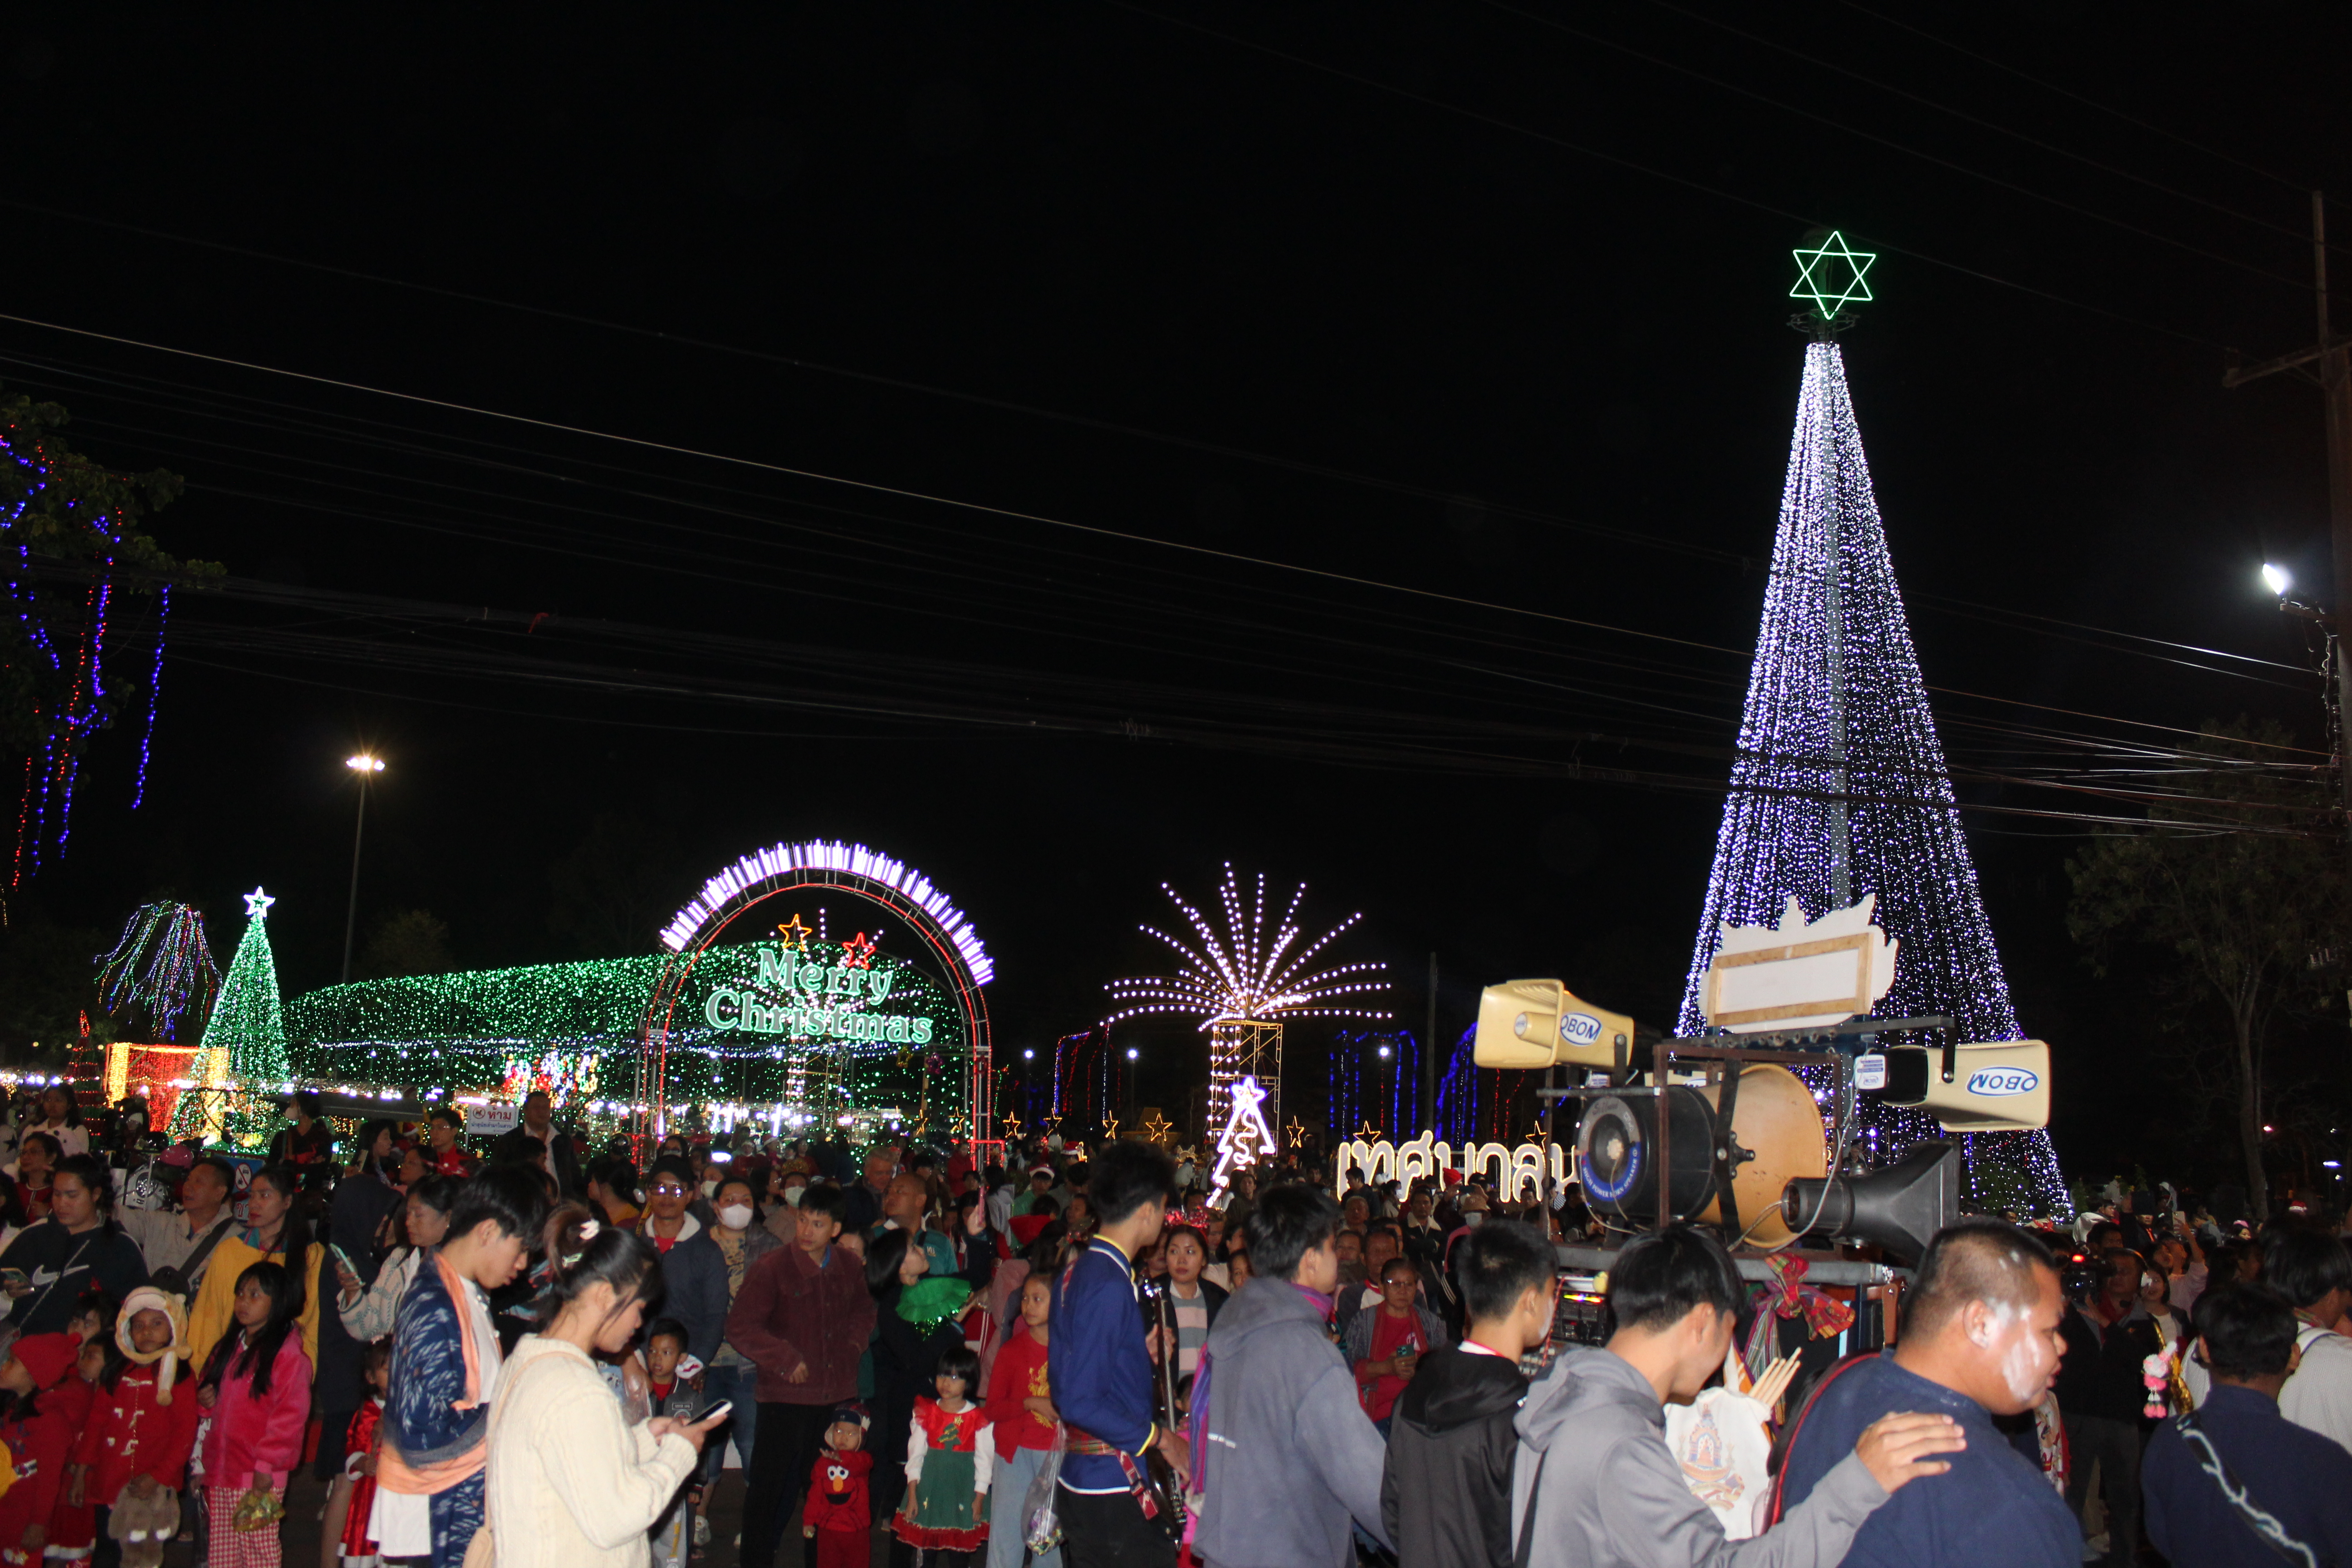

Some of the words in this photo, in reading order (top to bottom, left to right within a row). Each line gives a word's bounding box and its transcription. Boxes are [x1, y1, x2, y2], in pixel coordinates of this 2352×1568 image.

[758, 947, 894, 1006] Merry
[706, 989, 933, 1044] Christmas
[487, 1107, 511, 1120] ห้าม
[1592, 1184, 1609, 1198] POWER
